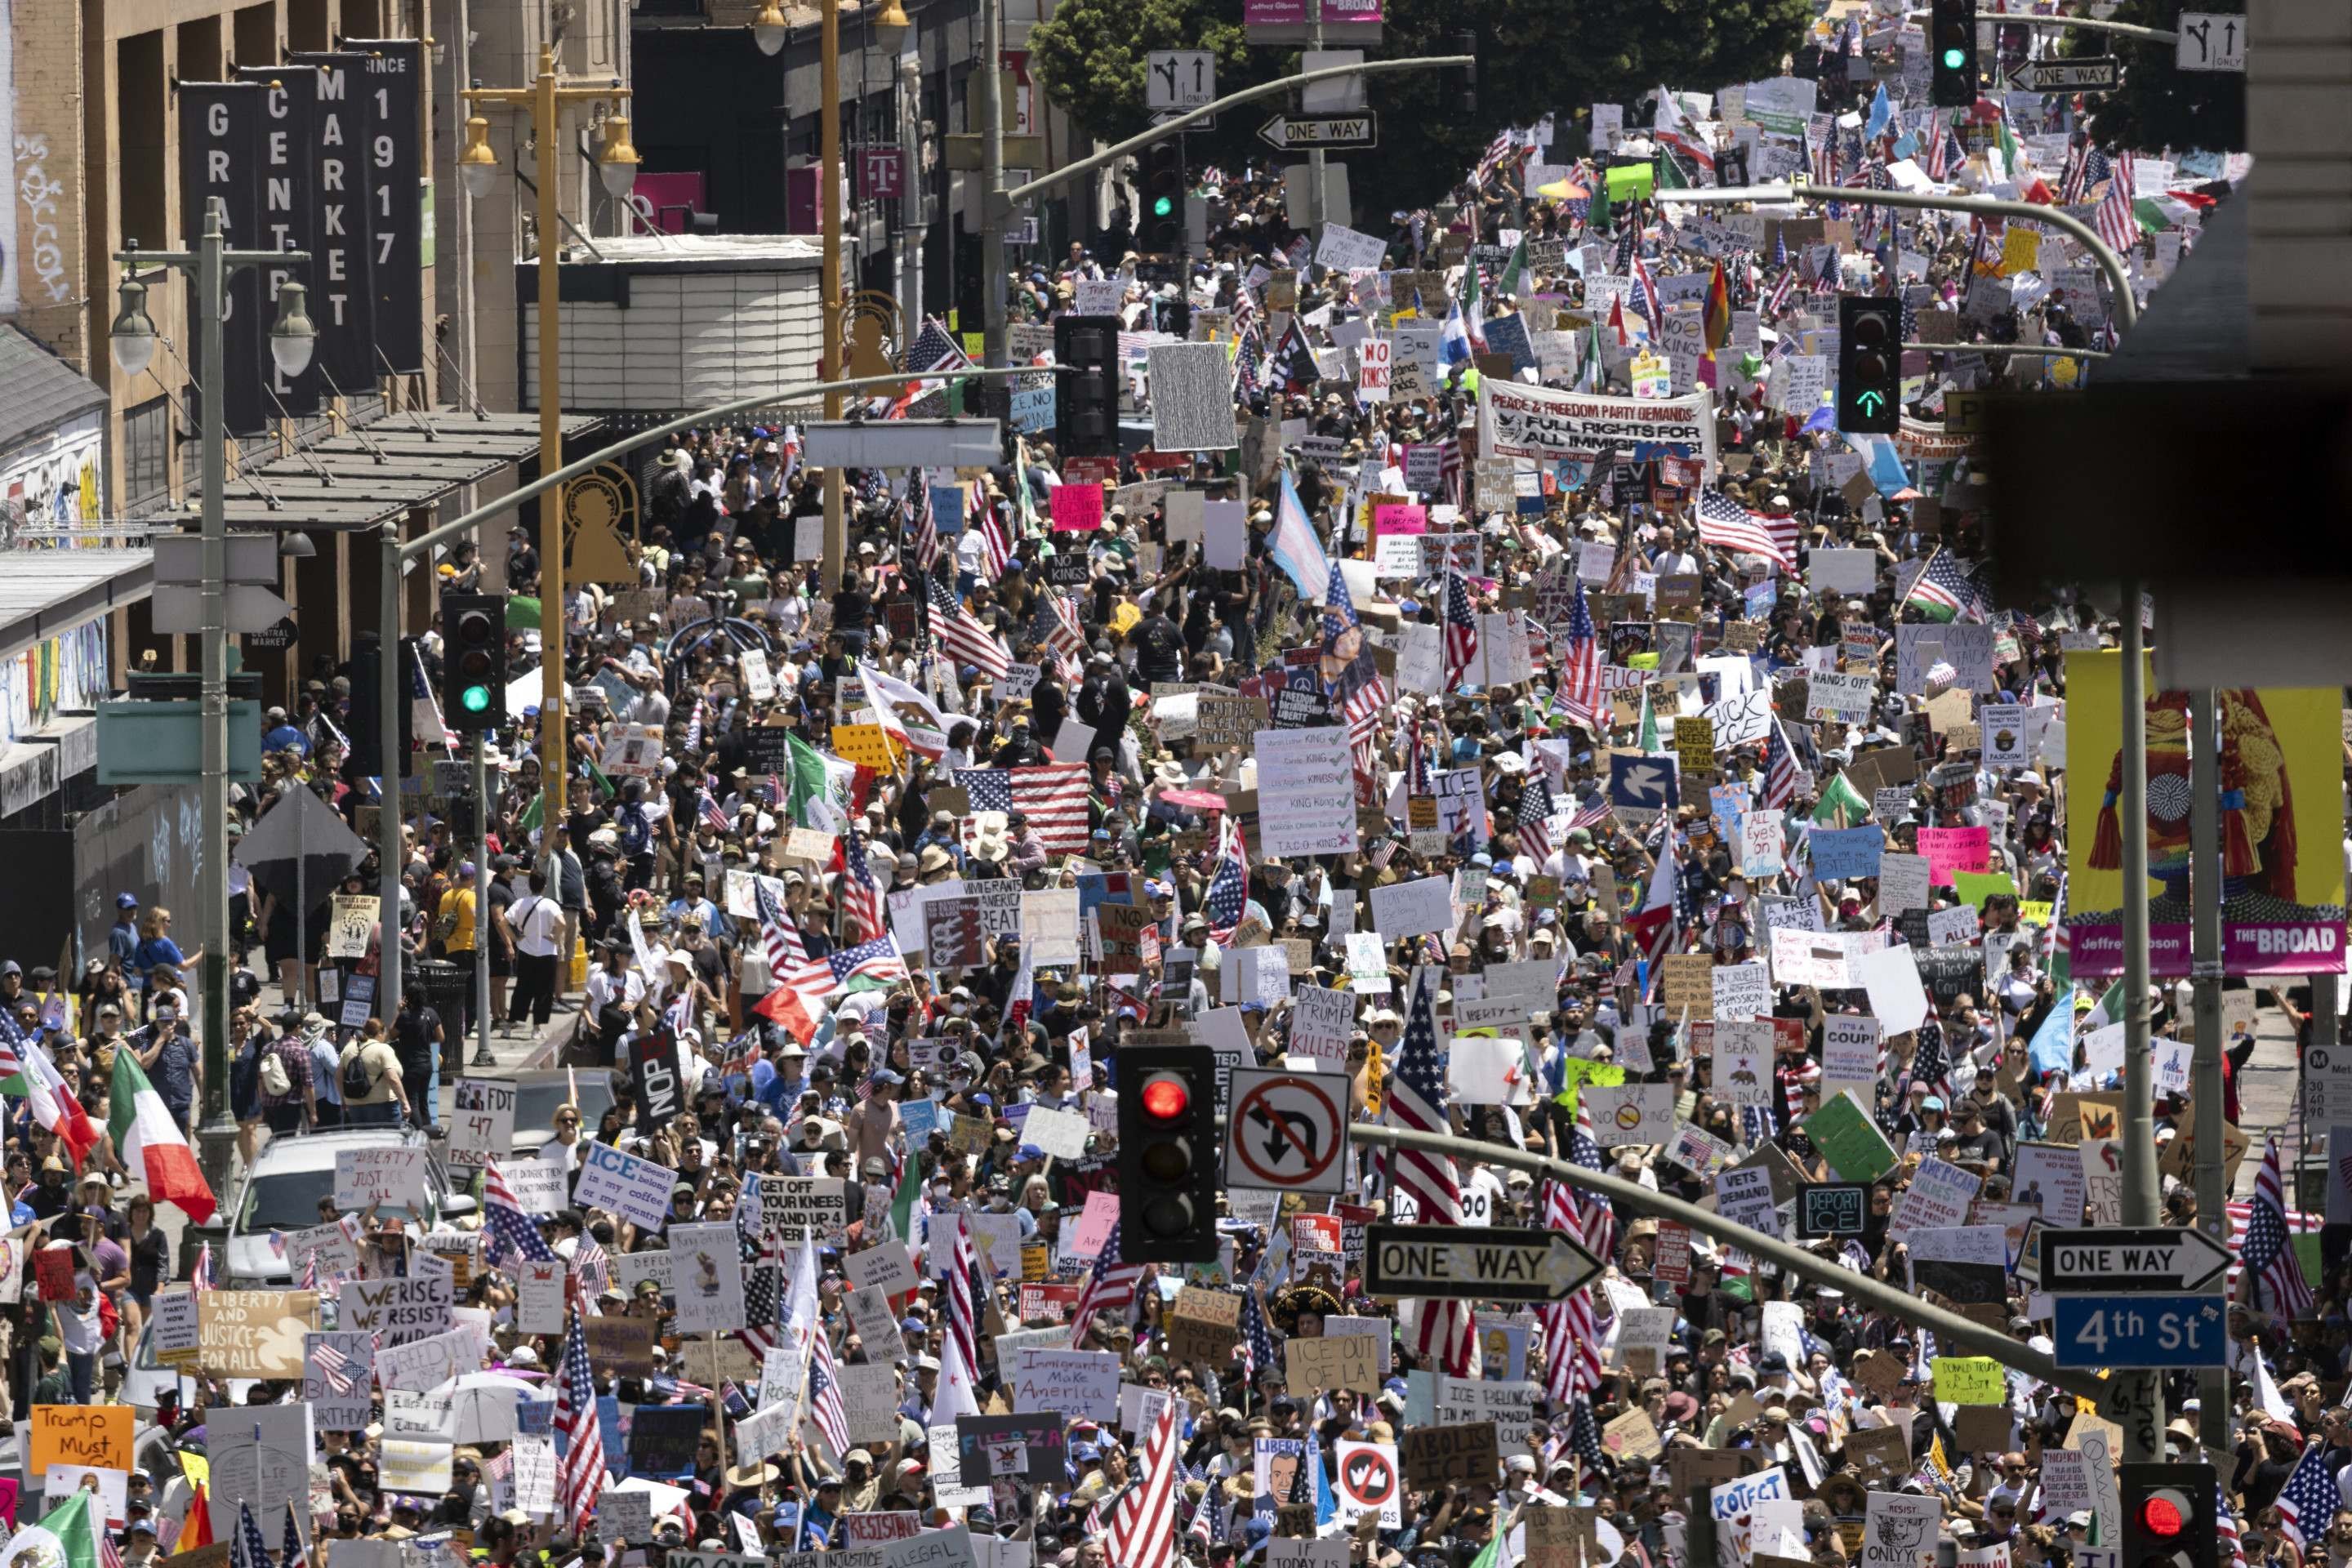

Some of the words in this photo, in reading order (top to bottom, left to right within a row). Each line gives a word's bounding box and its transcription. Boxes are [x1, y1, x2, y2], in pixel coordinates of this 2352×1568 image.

[1338, 0, 1377, 11] BROAD
[2216, 58, 2241, 66] ONLY
[2034, 69, 2063, 84] ONE
[2075, 67, 2107, 82] WAY
[1286, 123, 1316, 140] ONE
[1330, 121, 1365, 138] WAY
[868, 155, 897, 192] T
[318, 69, 347, 326] MARKET
[1664, 316, 1682, 335] NO
[1365, 343, 1388, 362] NO
[1662, 337, 1699, 357] KINGS
[1361, 367, 1388, 389] KINGS
[1491, 394, 1528, 412] PEACE
[1546, 401, 1598, 420] FREEDOM
[1603, 403, 1634, 421] PARTY
[1526, 416, 1578, 433] FULL
[1583, 422, 1654, 438] RIGHTS
[1658, 425, 1700, 439] FOR
[1054, 555, 1071, 567] NO
[1052, 568, 1087, 581] KINGS
[252, 639, 286, 648] MARKET
[1601, 669, 1653, 688] FUCK
[1813, 672, 1847, 686] HANDS
[1851, 678, 1870, 688] OFF
[1006, 688, 1023, 697] LA
[1305, 735, 1326, 745] KING
[1677, 734, 1712, 745] NEEDS
[1307, 754, 1327, 764] KING
[1436, 770, 1478, 798] ICE
[1290, 798, 1312, 808] KING
[1750, 812, 1769, 824] ALL
[1747, 826, 1776, 845] Eyes
[1463, 871, 1485, 881] GET
[1460, 887, 1485, 899] FREE
[1783, 895, 1815, 911] FREE
[1766, 909, 1818, 927] COUNTRY
[1945, 929, 1969, 944] ALL
[2235, 929, 2256, 942] THE
[2257, 928, 2336, 952] BROAD
[1930, 948, 1959, 961] Show
[1962, 950, 1982, 963] Up
[1298, 985, 1351, 1008] DONALD
[1299, 1003, 1351, 1024] TRUMP
[1726, 1006, 1767, 1020] RADICAL
[1321, 1025, 1341, 1036] THE
[1838, 1022, 1855, 1031] IT'S
[1733, 1032, 1750, 1042] THE
[1828, 1031, 1875, 1045] COUP!
[1291, 1032, 1346, 1059] KILLER
[1724, 1042, 1758, 1054] BEAR
[2310, 1082, 2324, 1092] 30
[488, 1087, 515, 1111] FDT
[1737, 1091, 1749, 1102] IN
[1753, 1089, 1771, 1102] CA
[468, 1116, 493, 1137] 47
[588, 1146, 641, 1182] ICE
[353, 1170, 406, 1187] JUSTICE
[641, 1164, 672, 1182] doesn't
[1725, 1171, 1758, 1187] VETS
[1917, 1156, 1980, 1194] AMERICAN
[588, 1172, 599, 1183] in
[604, 1179, 623, 1194] my
[629, 1188, 664, 1206] coffee
[637, 1174, 668, 1193] belong
[760, 1180, 786, 1192] GET
[787, 1181, 813, 1193] OFF
[368, 1189, 392, 1199] ALL
[760, 1195, 799, 1209] YOUR
[800, 1195, 844, 1209] KNEES
[1720, 1185, 1770, 1205] DEMAND
[1808, 1192, 1860, 1210] DEPORT
[583, 1187, 595, 1196] or
[599, 1194, 618, 1208] my
[622, 1203, 662, 1225] country
[762, 1211, 807, 1224] STAND
[812, 1211, 828, 1224] UP
[832, 1211, 840, 1223] 4
[1295, 1219, 1316, 1228] KEEP
[1737, 1213, 1760, 1224] OUT
[1295, 1229, 1330, 1240] FAMILIES
[1294, 1239, 1334, 1250] TOGETHER
[1383, 1245, 1450, 1276] ONE
[1476, 1249, 1546, 1281] WAY
[1659, 1257, 1687, 1268] LAND
[2060, 1250, 2112, 1272] ONE
[2123, 1250, 2175, 1272] WAY
[1058, 1265, 1077, 1274] NOT
[868, 1272, 902, 1286] AMERICA
[161, 1295, 188, 1304] LABOR
[208, 1291, 287, 1307] LIBERTY
[357, 1284, 399, 1307] WE
[399, 1279, 448, 1305] RISE,
[1023, 1290, 1045, 1300] KEEP
[1182, 1290, 1239, 1307] RESIST
[1022, 1299, 1062, 1310] FAMILIES
[166, 1314, 185, 1322] NOW
[214, 1308, 247, 1322] AND
[352, 1309, 381, 1330] WE
[388, 1306, 449, 1327] RESIST,
[1179, 1304, 1235, 1322] FASCISM
[1340, 1318, 1371, 1328] STOP
[2076, 1310, 2144, 1352] 4th
[2158, 1312, 2200, 1350] St
[199, 1325, 256, 1347] JUSTICE
[306, 1333, 365, 1356] FUCK
[1185, 1342, 1222, 1358] ICE
[1295, 1340, 1333, 1363] ICE
[1342, 1335, 1375, 1360] OUT
[200, 1349, 227, 1371] FOR
[229, 1348, 261, 1370] ALL
[1022, 1350, 1110, 1373] Immigrants
[1048, 1372, 1089, 1384] Make
[1305, 1365, 1335, 1388] OF
[1342, 1363, 1369, 1383] LA
[1020, 1379, 1104, 1400] America
[1450, 1386, 1476, 1403] ICE
[1037, 1401, 1094, 1415] Great
[1443, 1409, 1456, 1421] IN
[38, 1407, 106, 1437] Trump
[60, 1435, 112, 1456] Must
[1418, 1454, 1490, 1482] ICE
[1346, 1508, 1360, 1519] NO
[1889, 1505, 1918, 1514] RESIST
[1298, 1543, 1312, 1556] IF
[1869, 1546, 1899, 1562] ONLY
[785, 1553, 817, 1568] WHEN
[824, 1551, 883, 1568] INJUSTICE
[1273, 1557, 1316, 1568] TODAY
[1323, 1559, 1339, 1568] IS
